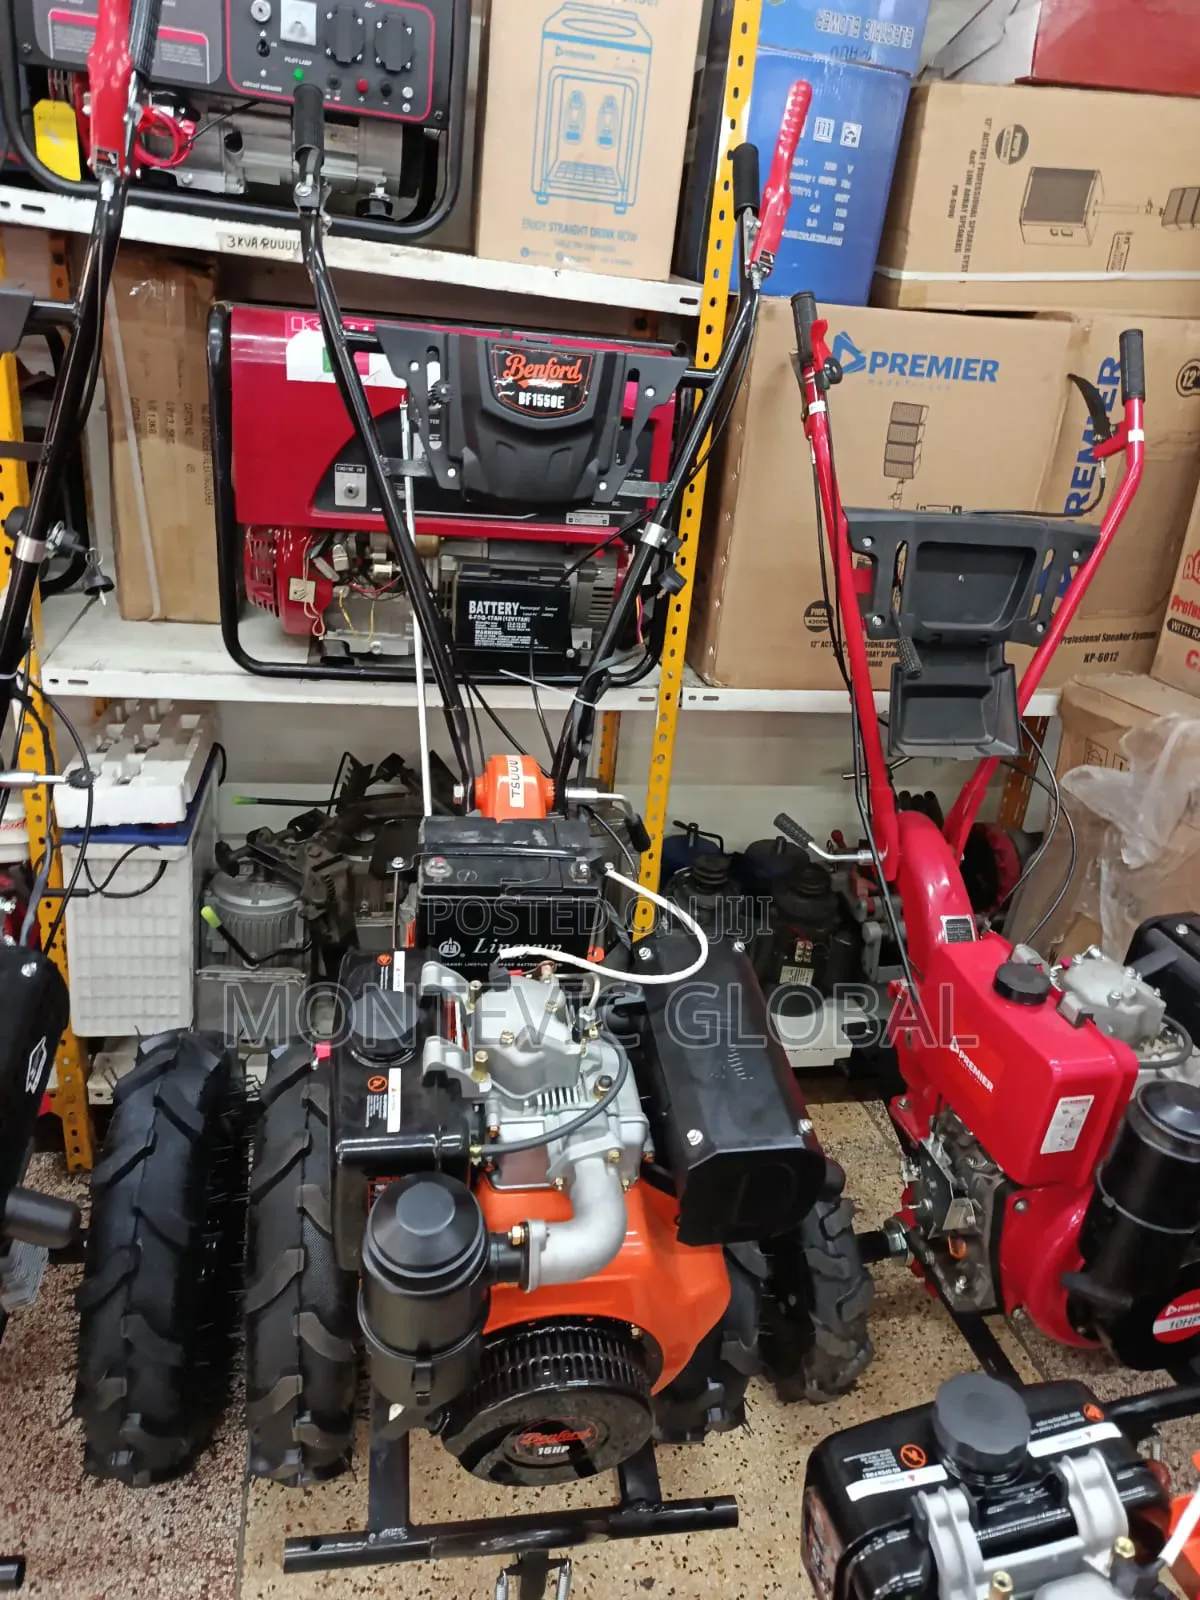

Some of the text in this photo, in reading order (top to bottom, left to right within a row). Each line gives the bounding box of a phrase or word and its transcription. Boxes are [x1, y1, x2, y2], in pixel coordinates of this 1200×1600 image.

[815, 8, 914, 48] ELECTRIC BLOWER
[284, 56, 299, 65] PILOT
[261, 83, 282, 92] BREAKER
[965, 170, 973, 188] LINE
[970, 161, 986, 218] PROFESSIONAL
[960, 188, 970, 215] ARRAY
[548, 221, 588, 238] STRAIGHT
[965, 219, 978, 254] SPEAKER
[503, 353, 582, 384] Benford
[869, 351, 1000, 383] PREMIER
[468, 600, 520, 615] BATTERY
[1172, 621, 1191, 636] WITH
[958, 1050, 994, 1093] PREMIER
